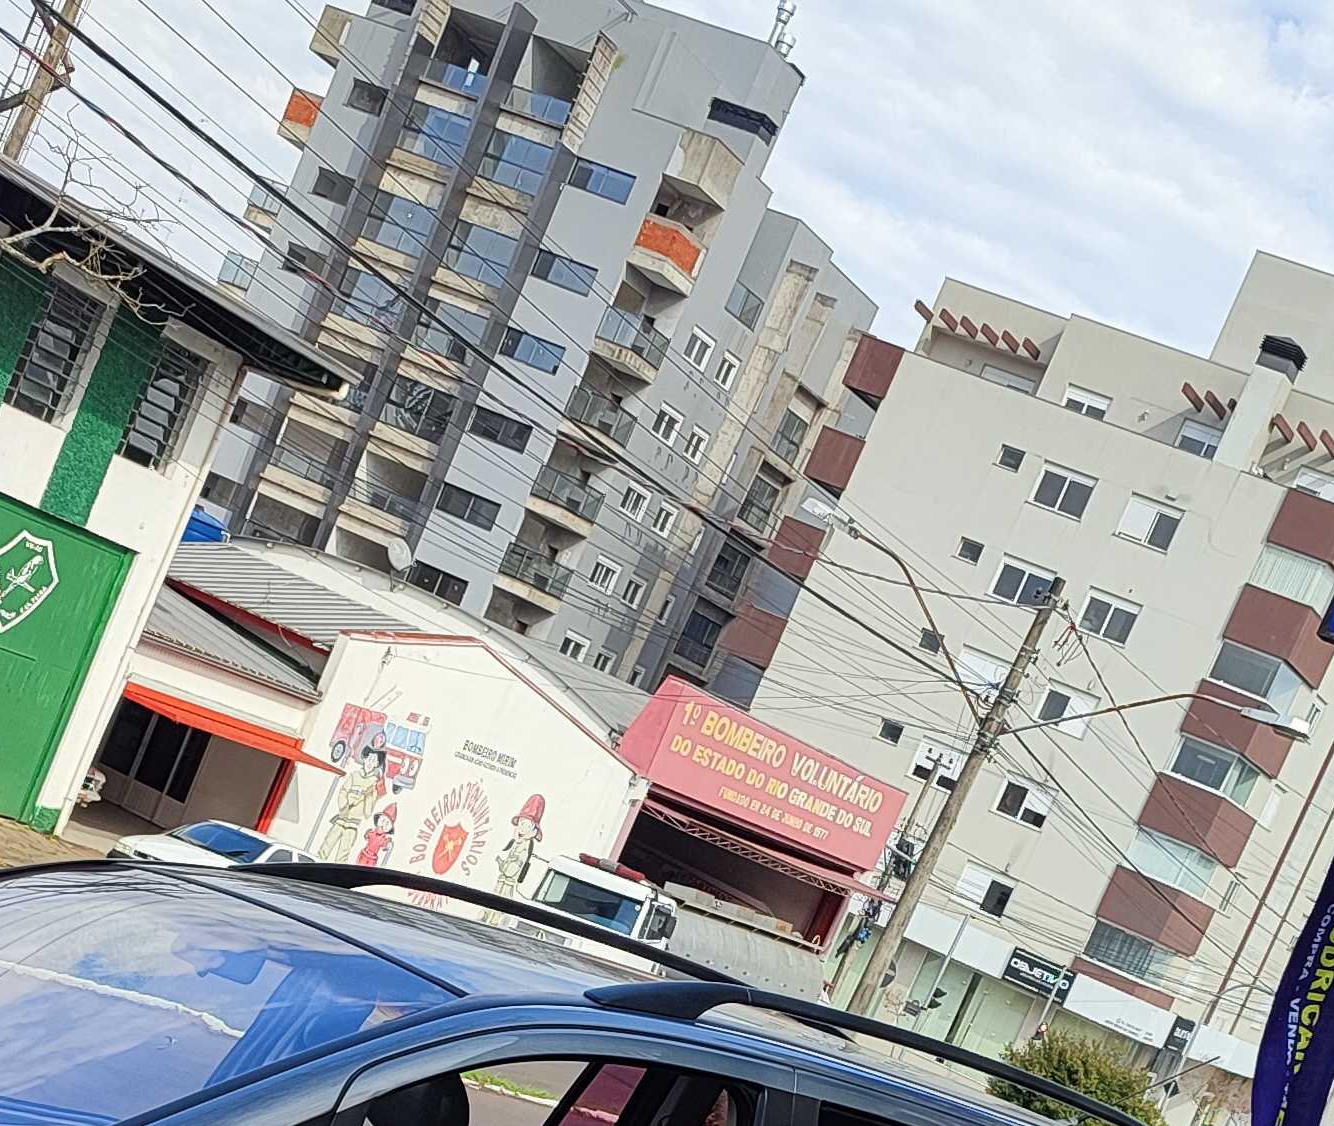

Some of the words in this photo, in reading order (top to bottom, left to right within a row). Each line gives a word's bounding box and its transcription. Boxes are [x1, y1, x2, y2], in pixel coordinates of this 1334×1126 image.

[670, 734, 692, 757] DO
[692, 744, 746, 780] ESTADO
[746, 769, 765, 790] DO
[765, 777, 790, 803] RIO
[787, 787, 837, 822] GRANDE
[836, 807, 855, 829] DO
[853, 817, 873, 838] SUL
[700, 710, 787, 768] BOMBEIRO
[790, 751, 884, 814] VOLUNTÁRIO
[409, 783, 465, 865] BOMBEIROS
[460, 778, 493, 877] VOLUNTÁRIOS
